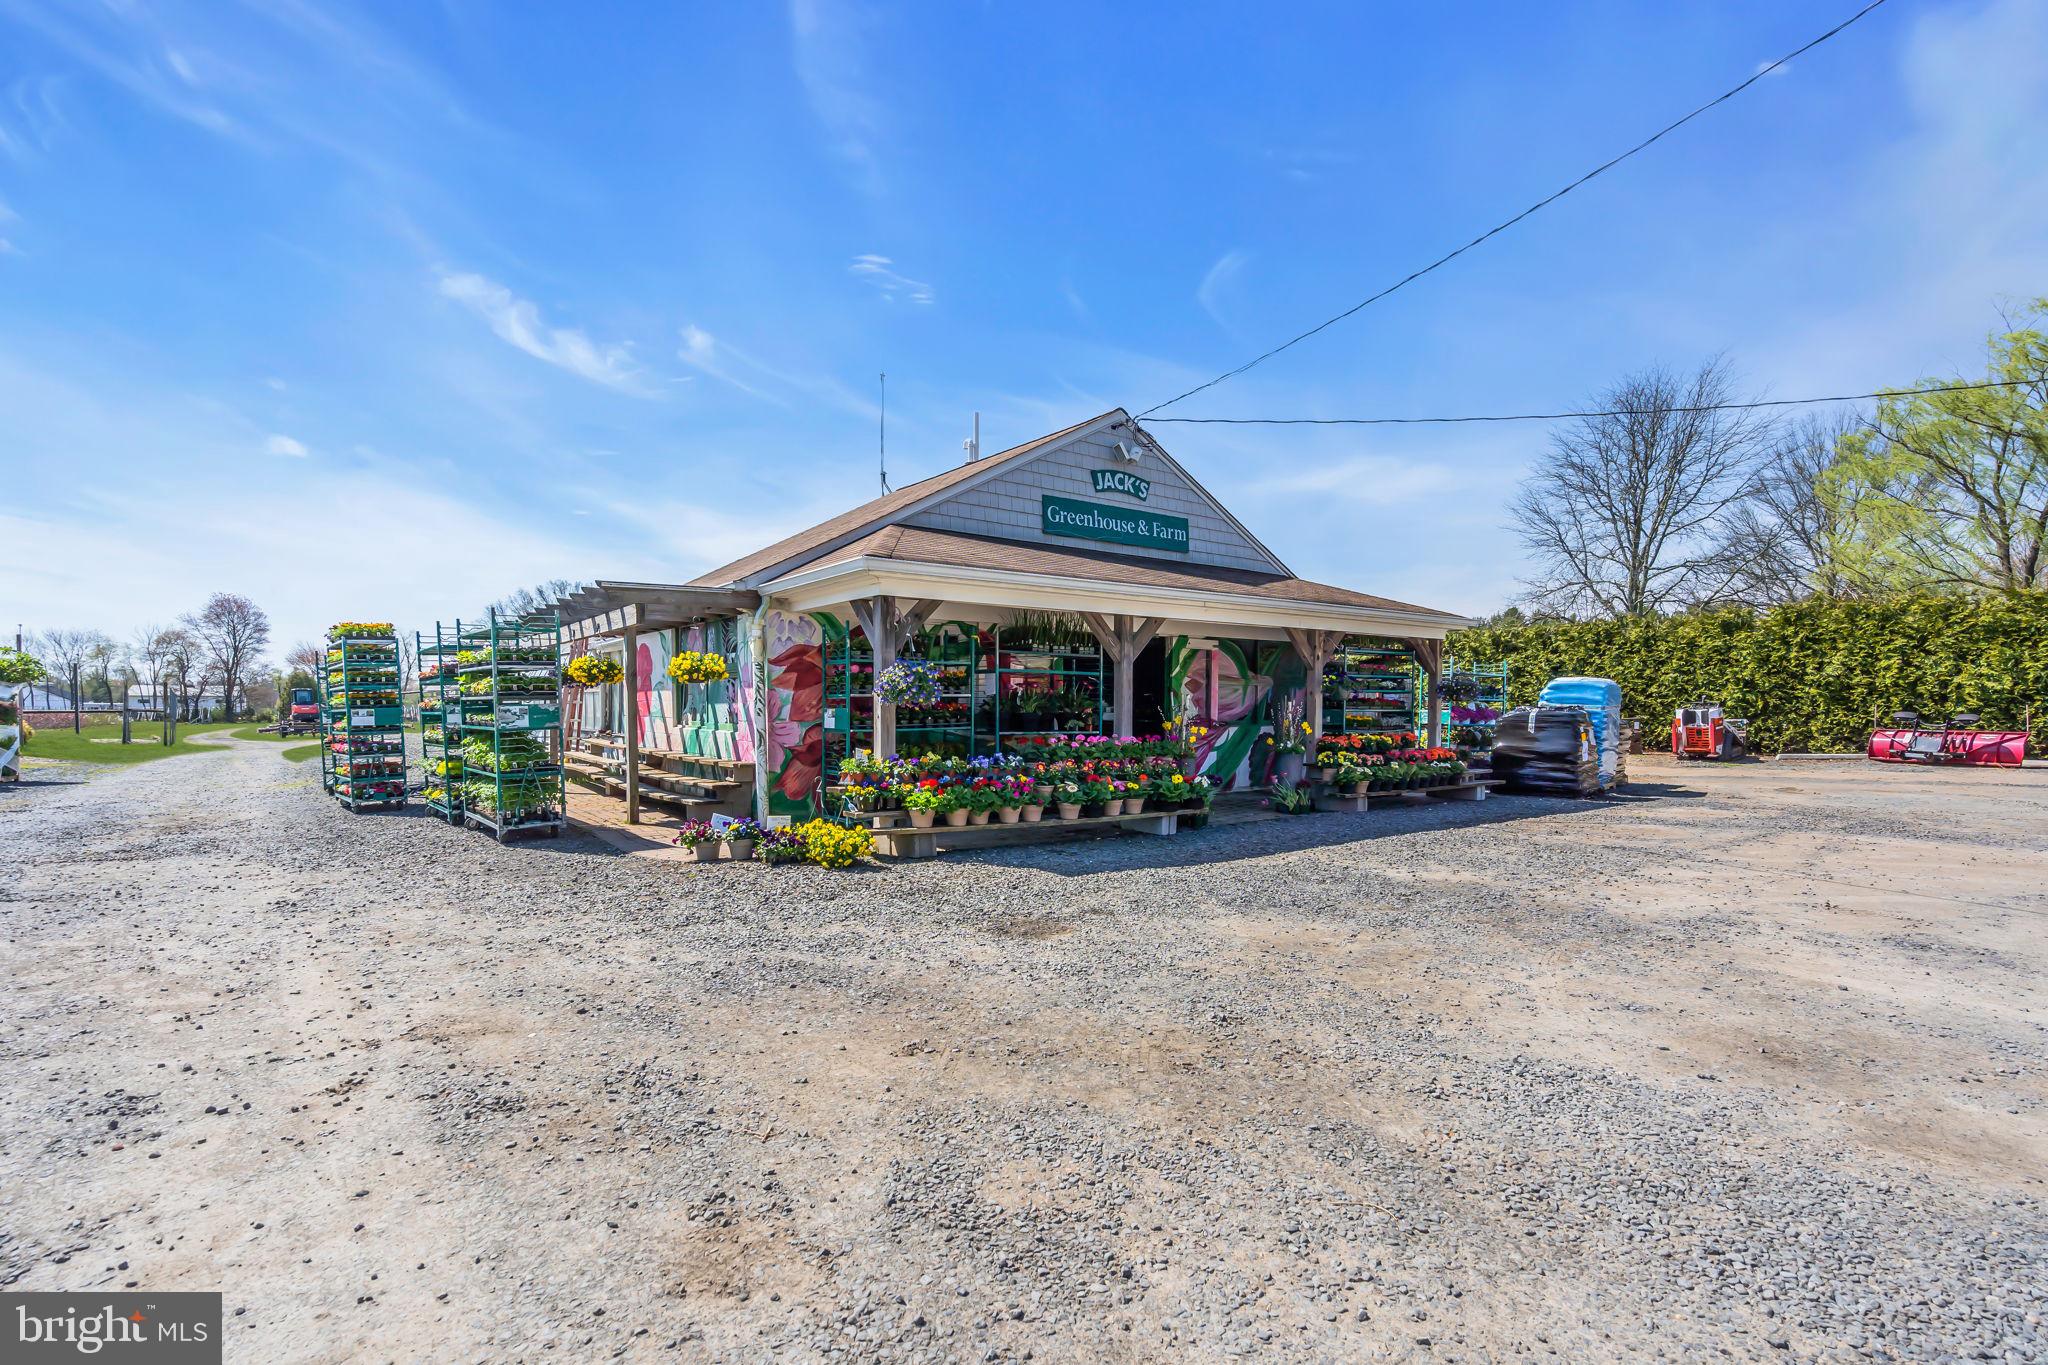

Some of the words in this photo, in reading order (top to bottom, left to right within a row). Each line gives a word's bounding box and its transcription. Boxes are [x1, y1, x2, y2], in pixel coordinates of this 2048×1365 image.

[1096, 472, 1149, 499] JACK'S
[1047, 505, 1135, 534] Greenhouse
[1138, 519, 1150, 536] &
[1152, 522, 1187, 542] Farm
